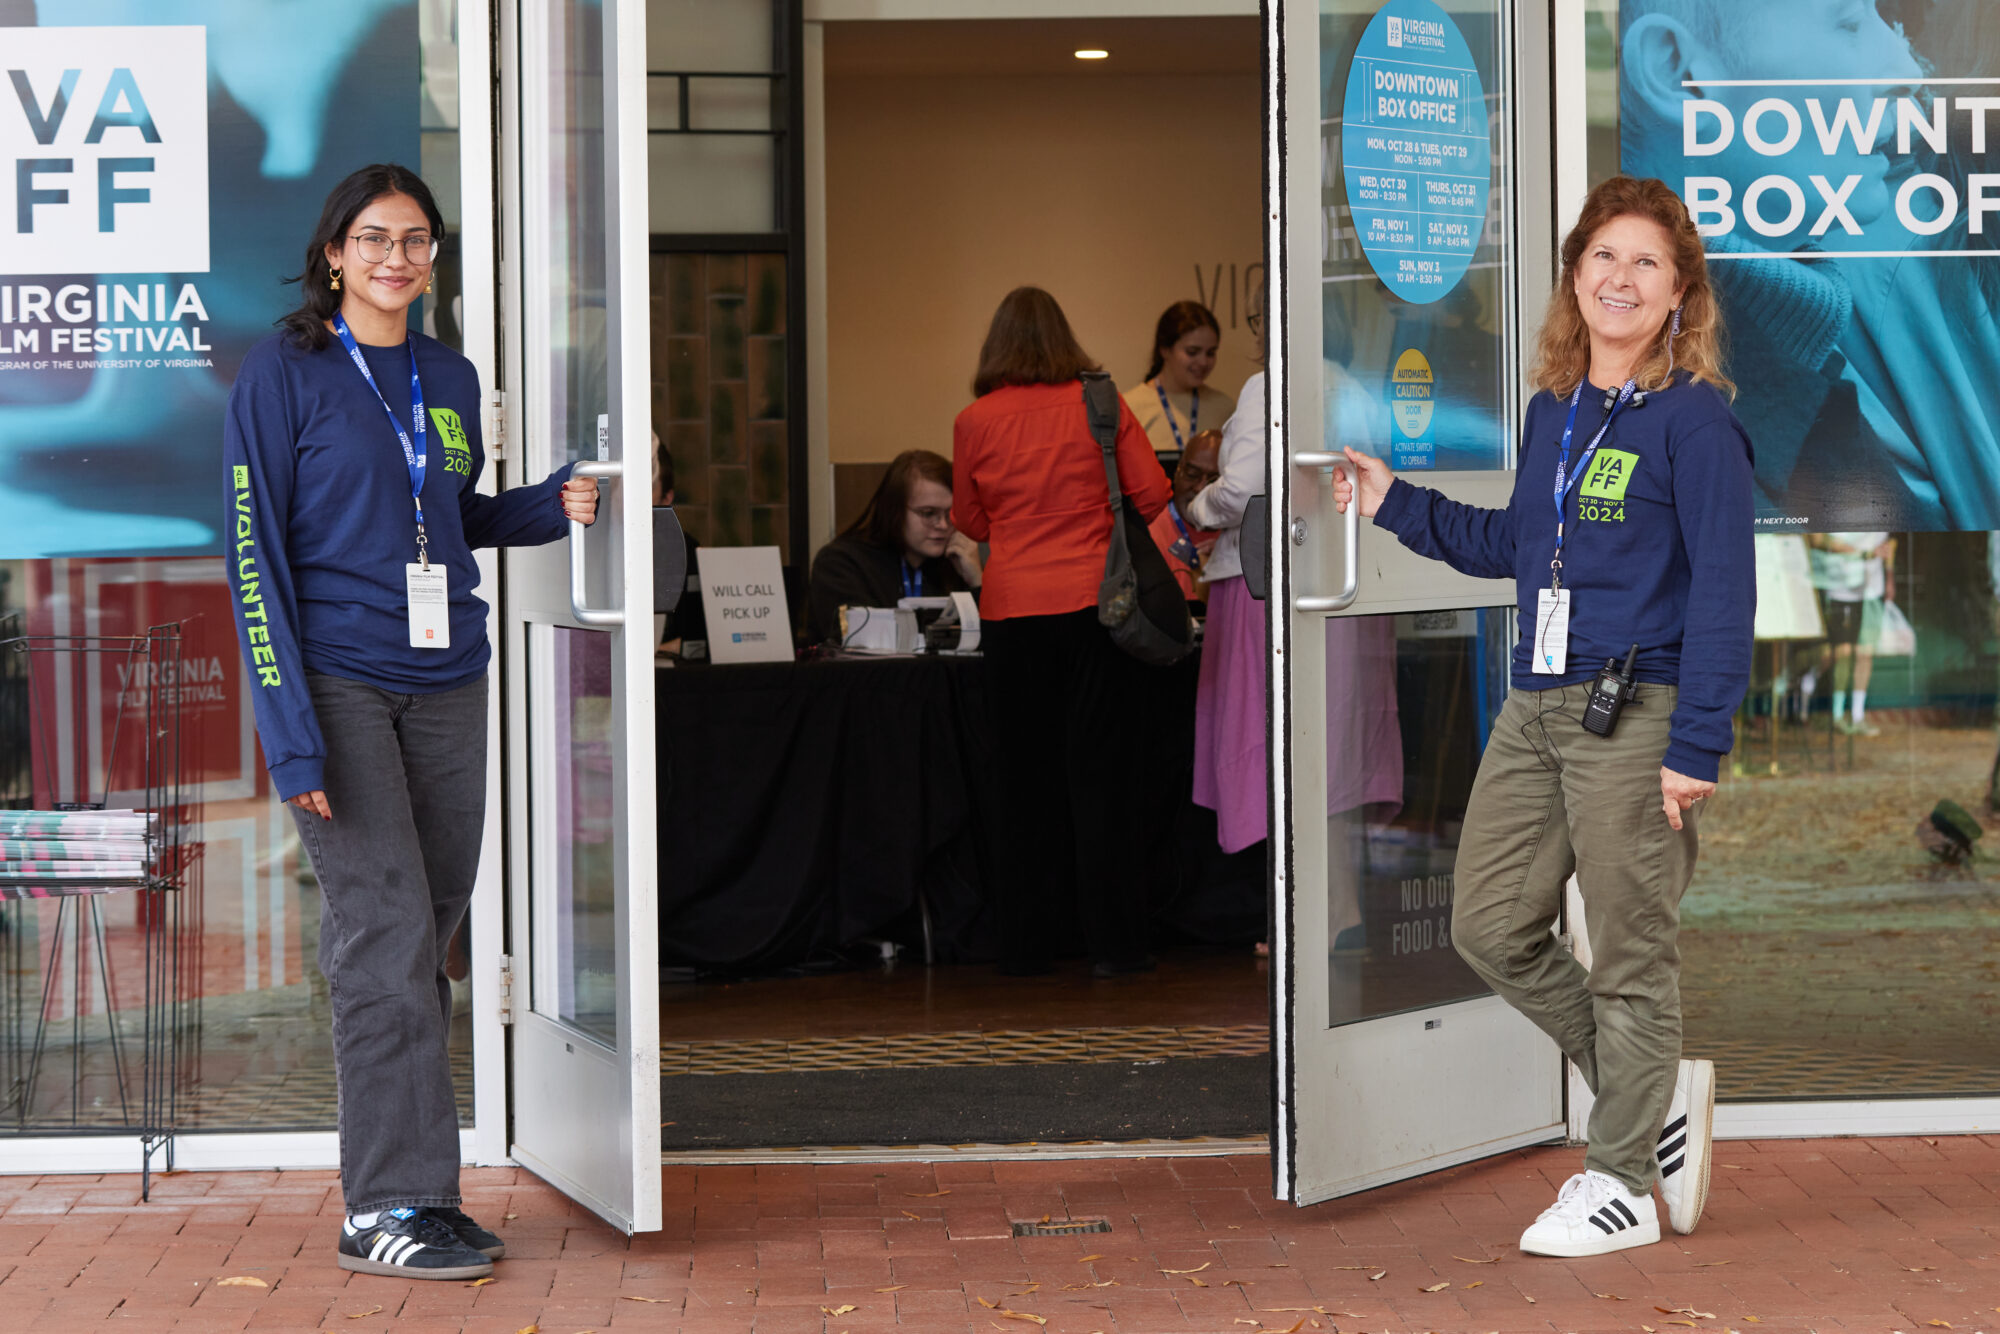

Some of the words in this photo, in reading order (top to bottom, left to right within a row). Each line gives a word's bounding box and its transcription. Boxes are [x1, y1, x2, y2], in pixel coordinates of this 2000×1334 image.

[1403, 18, 1445, 38] VIRGINIA
[1404, 33, 1417, 44] FILM
[1418, 35, 1446, 48] FESTIVAL
[1375, 70, 1459, 98] DOWNTOWN
[7, 68, 163, 145] VA
[1379, 97, 1406, 118] BOX
[1409, 100, 1456, 123] OFFICE
[1682, 96, 2000, 156] DOWNT
[1367, 138, 1386, 152] MON,
[1388, 140, 1403, 152] OCT
[1404, 142, 1413, 153] 28
[1414, 143, 1419, 153] &
[1421, 143, 1441, 156] TUES,
[1442, 145, 1457, 157] OCT
[1459, 146, 1467, 158] 29
[1394, 154, 1413, 164] NOON
[1418, 156, 1431, 166] 5:00
[1433, 157, 1441, 167] PM
[1359, 176, 1379, 190] WED,
[1380, 178, 1395, 188] OCT
[1397, 179, 1407, 190] 30
[1426, 181, 1451, 195] THURS,
[1452, 184, 1467, 195] OCT
[1469, 185, 1476, 196] 31
[16, 157, 155, 233] FF
[1359, 190, 1378, 200] NOON
[1384, 191, 1397, 201] 8:30
[1398, 193, 1407, 202] PM
[1428, 194, 1446, 205] NOON
[1465, 197, 1474, 207] PM
[1684, 174, 1864, 237] BOX
[1895, 173, 2000, 236] OF
[1372, 218, 1386, 232] FRI,
[1387, 220, 1404, 231] NOV
[1405, 220, 1409, 231] 1
[1428, 222, 1445, 236] SAT,
[1446, 223, 1462, 235] NOV
[1463, 225, 1468, 235] 2
[1367, 232, 1375, 241] 10
[1376, 232, 1386, 242] AM
[1390, 233, 1404, 243] 8:30
[1405, 234, 1414, 243] PM
[1427, 235, 1431, 245] 9
[1433, 236, 1442, 246] AM
[1447, 237, 1459, 247] 8:45
[1460, 238, 1470, 247] PM
[1399, 260, 1417, 273] SUN,
[1417, 261, 1434, 272] NOV
[1435, 262, 1440, 273] 3
[1397, 273, 1404, 283] 10
[1405, 274, 1415, 283] AM
[1420, 274, 1432, 284] 8:30
[1433, 275, 1442, 284] PM
[2, 283, 209, 323] IRGINIA
[51, 327, 211, 353] FESTIVAL
[33, 360, 49, 370] OF
[52, 360, 73, 369] THE
[76, 359, 142, 369] UNIVERSITY
[144, 359, 161, 368] OF
[163, 358, 214, 368] VIRGINIA
[1397, 369, 1428, 379] AUTOMATIC
[1396, 385, 1430, 398] CAUTION
[416, 402, 426, 434] VIRGINIA
[1405, 406, 1421, 415] DOOR
[447, 429, 466, 444] FF
[398, 432, 413, 465] VIRGINIA
[1395, 443, 1415, 452] ACTIVATE
[1416, 443, 1432, 452] SWITCH
[1401, 456, 1407, 465] TO
[1408, 456, 1427, 465] OPERATE
[1600, 456, 1622, 474] VA
[1589, 473, 1619, 490] FF
[1579, 504, 1626, 522] 2024
[236, 491, 282, 687] VOLUNTEER
[712, 585, 743, 597] WILL
[745, 584, 775, 596] CALL
[723, 607, 751, 620] PICK
[753, 606, 770, 619] UP
[117, 656, 225, 688] VIRGINIA
[1401, 878, 1422, 912] NO
[1392, 918, 1432, 956] FOOD
[1437, 916, 1448, 948] &
